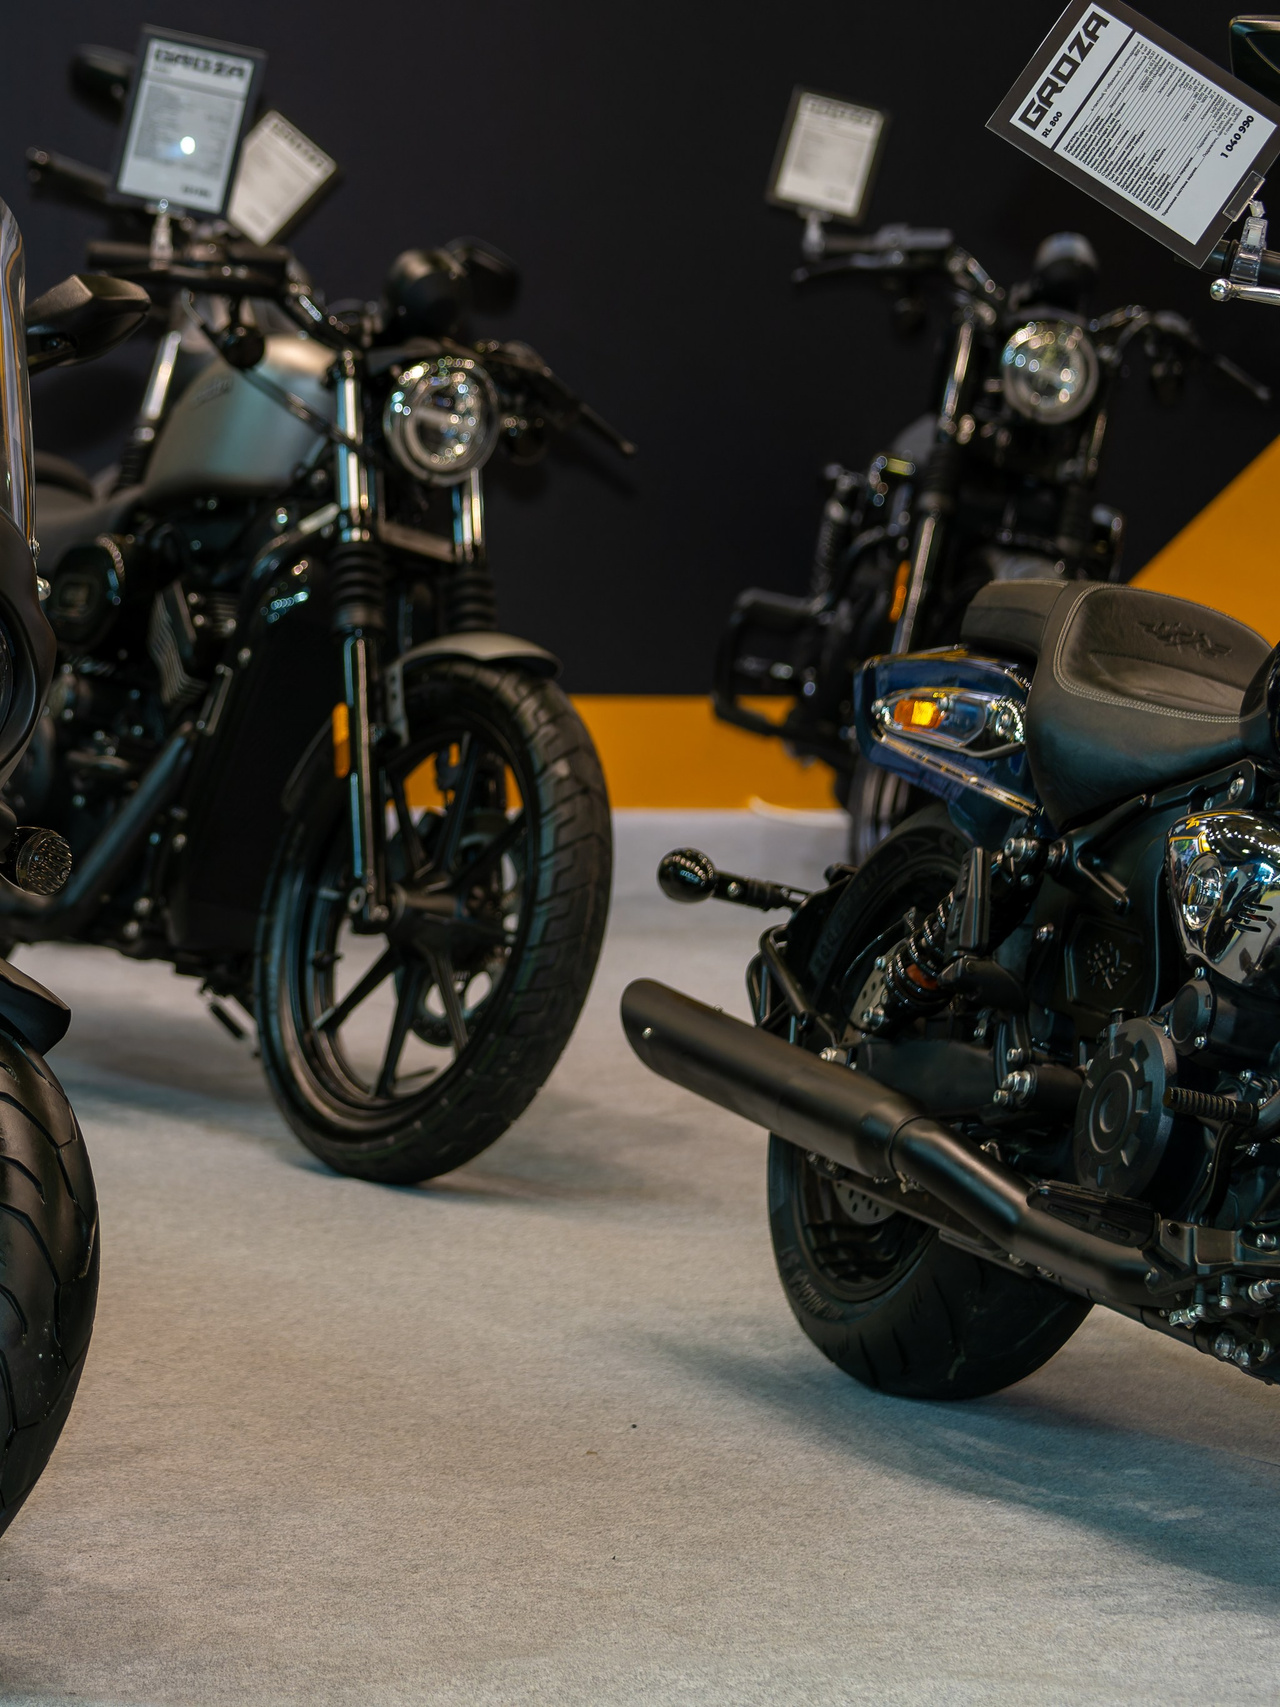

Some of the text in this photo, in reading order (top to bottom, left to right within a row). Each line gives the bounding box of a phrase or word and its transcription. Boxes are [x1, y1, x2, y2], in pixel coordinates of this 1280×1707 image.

[1018, 11, 1110, 131] GROZA
[1042, 111, 1063, 138] RL 800
[1225, 133, 1242, 152] 040
[1238, 115, 1255, 134] 990
